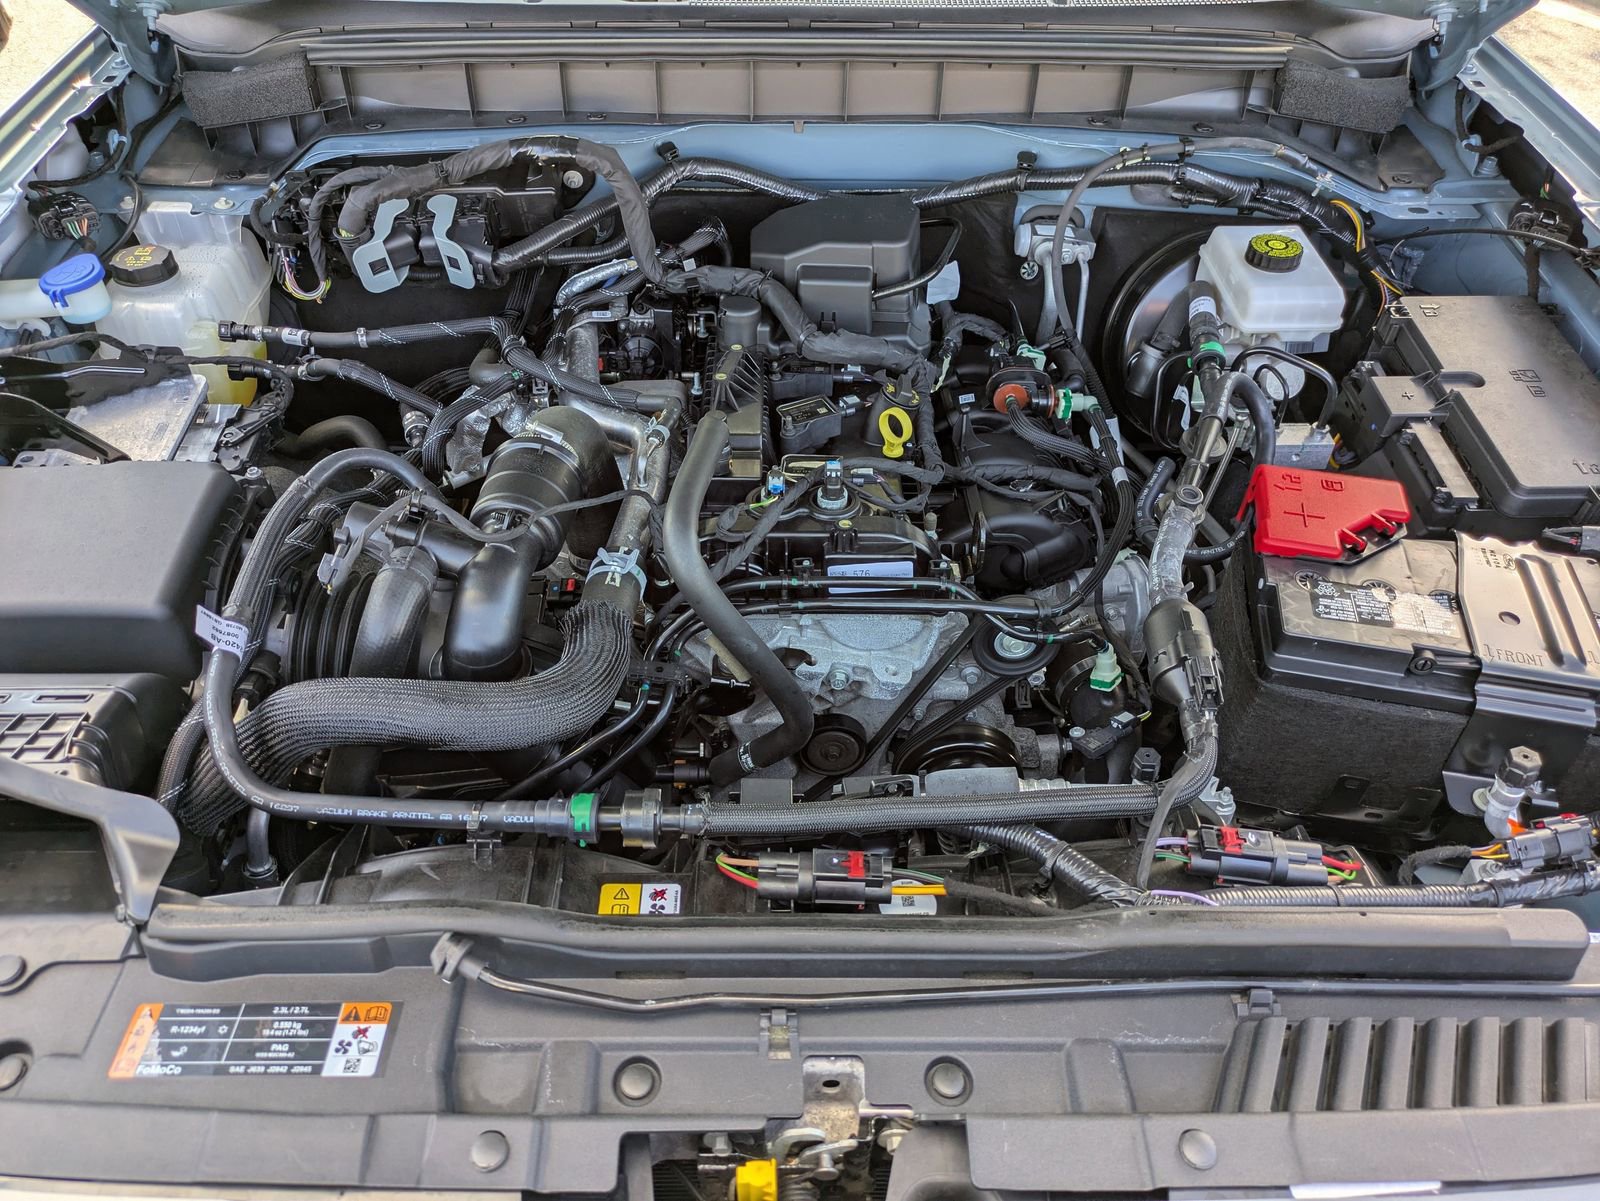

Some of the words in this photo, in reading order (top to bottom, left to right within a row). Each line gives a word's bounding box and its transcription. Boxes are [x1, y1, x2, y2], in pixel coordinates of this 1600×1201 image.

[1496, 648, 1545, 667] FRONT
[316, 807, 353, 816] VACUUM
[357, 809, 388, 818] BRAKE
[392, 811, 434, 820] ARNITEL
[170, 1025, 206, 1035] R-1234yf
[136, 1064, 182, 1075] FoMoCo
